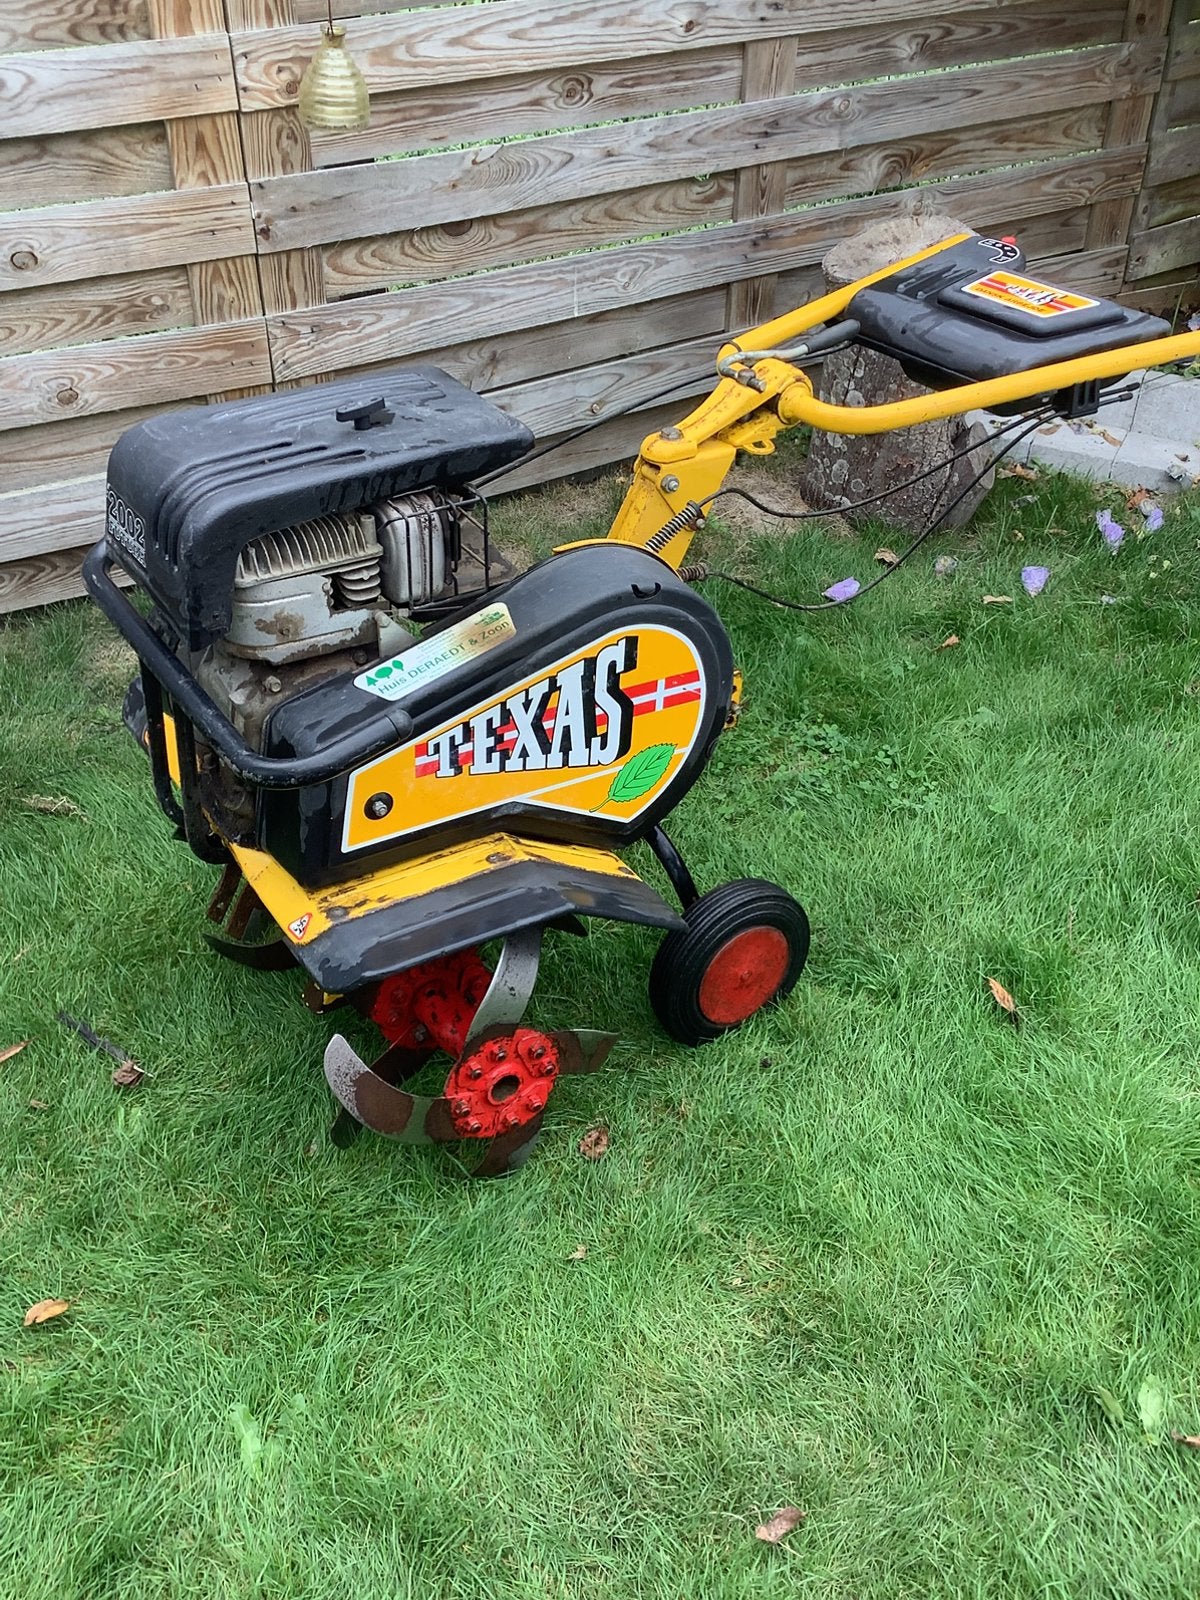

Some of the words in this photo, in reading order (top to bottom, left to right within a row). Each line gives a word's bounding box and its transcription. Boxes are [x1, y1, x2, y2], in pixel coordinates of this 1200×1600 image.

[107, 490, 147, 550] 2002
[378, 677, 407, 695] Huis
[408, 643, 466, 679] DERAEDT
[468, 637, 478, 646] &
[481, 621, 510, 640] Zoon
[427, 635, 639, 778] TEXAS
